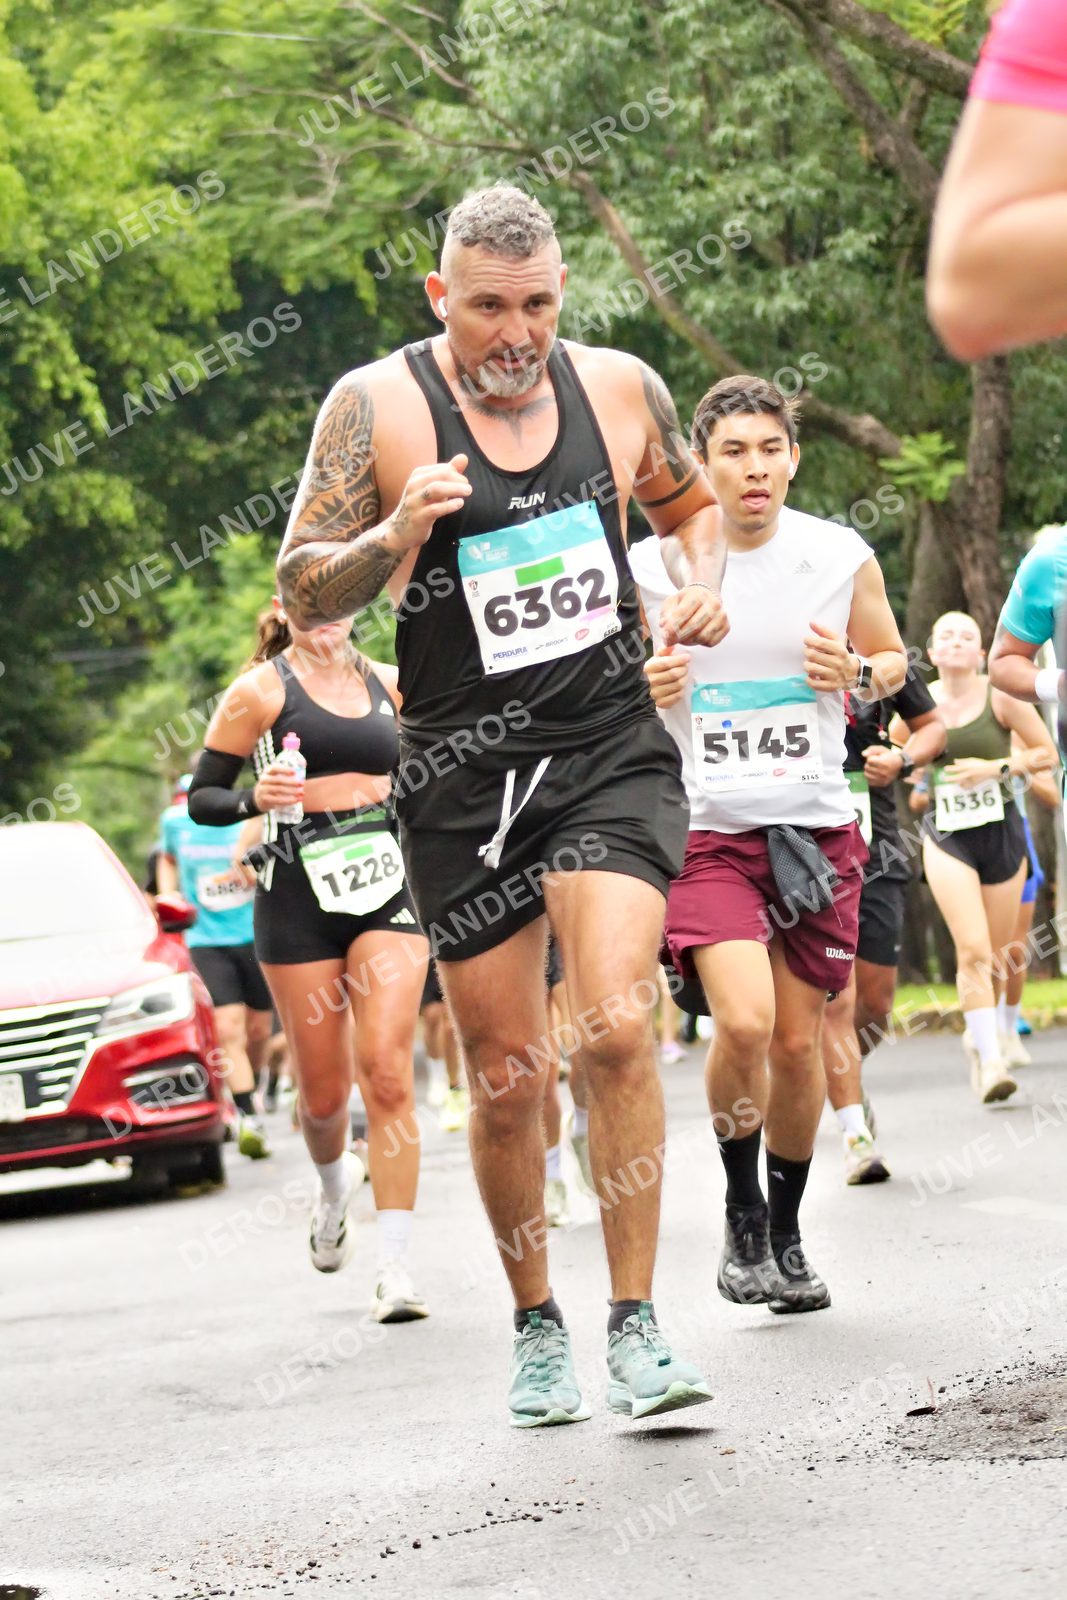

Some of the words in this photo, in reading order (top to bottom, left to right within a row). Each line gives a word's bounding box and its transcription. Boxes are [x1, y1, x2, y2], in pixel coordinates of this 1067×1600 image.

[508, 491, 546, 510] RUN
[484, 568, 612, 637] 6362
[492, 646, 528, 659] PERDURA
[703, 724, 810, 764] 5145
[942, 790, 996, 813] 1536
[322, 852, 400, 897] 1228
